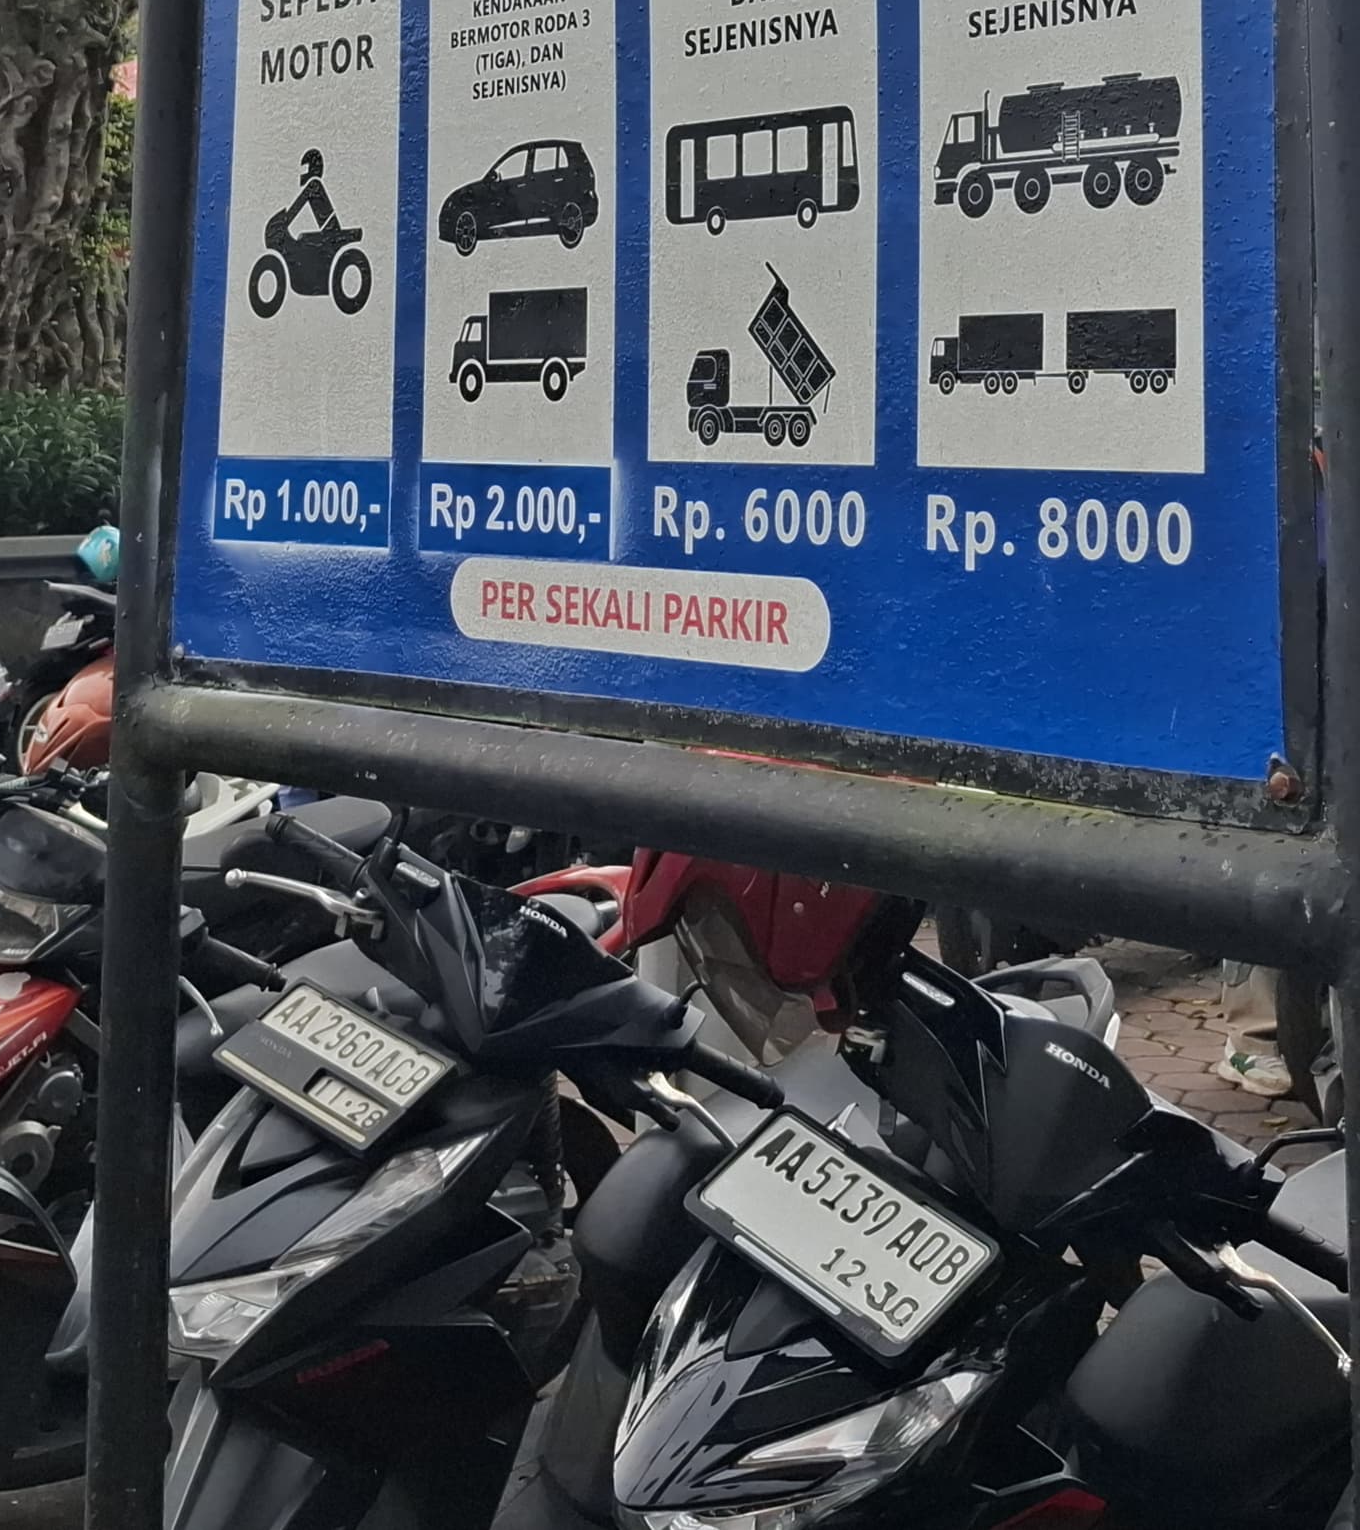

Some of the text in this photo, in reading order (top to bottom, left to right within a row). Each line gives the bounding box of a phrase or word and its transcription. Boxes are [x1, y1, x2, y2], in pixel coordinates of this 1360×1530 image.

[451, 9, 591, 49] BERMOTOR RODA 3
[684, 8, 839, 57] SEJENISNYA
[261, 34, 374, 84] MOTOR
[476, 41, 564, 75] (TIGA), DAN
[473, 70, 566, 100] SEJENISNYA)
[224, 478, 381, 533] Rp 1.000,-
[429, 482, 601, 544] Rp 2.000,-
[653, 485, 866, 554] Rp. 6000
[926, 494, 1192, 571] Rp. 8000
[481, 580, 789, 645] PER SEKALI PARKIR
[519, 905, 568, 938] HONDA
[273, 996, 322, 1036] AA
[307, 1013, 386, 1068] 2960
[1044, 1041, 1110, 1089] HONDA
[754, 1129, 970, 1285] AA 5139 AQB
